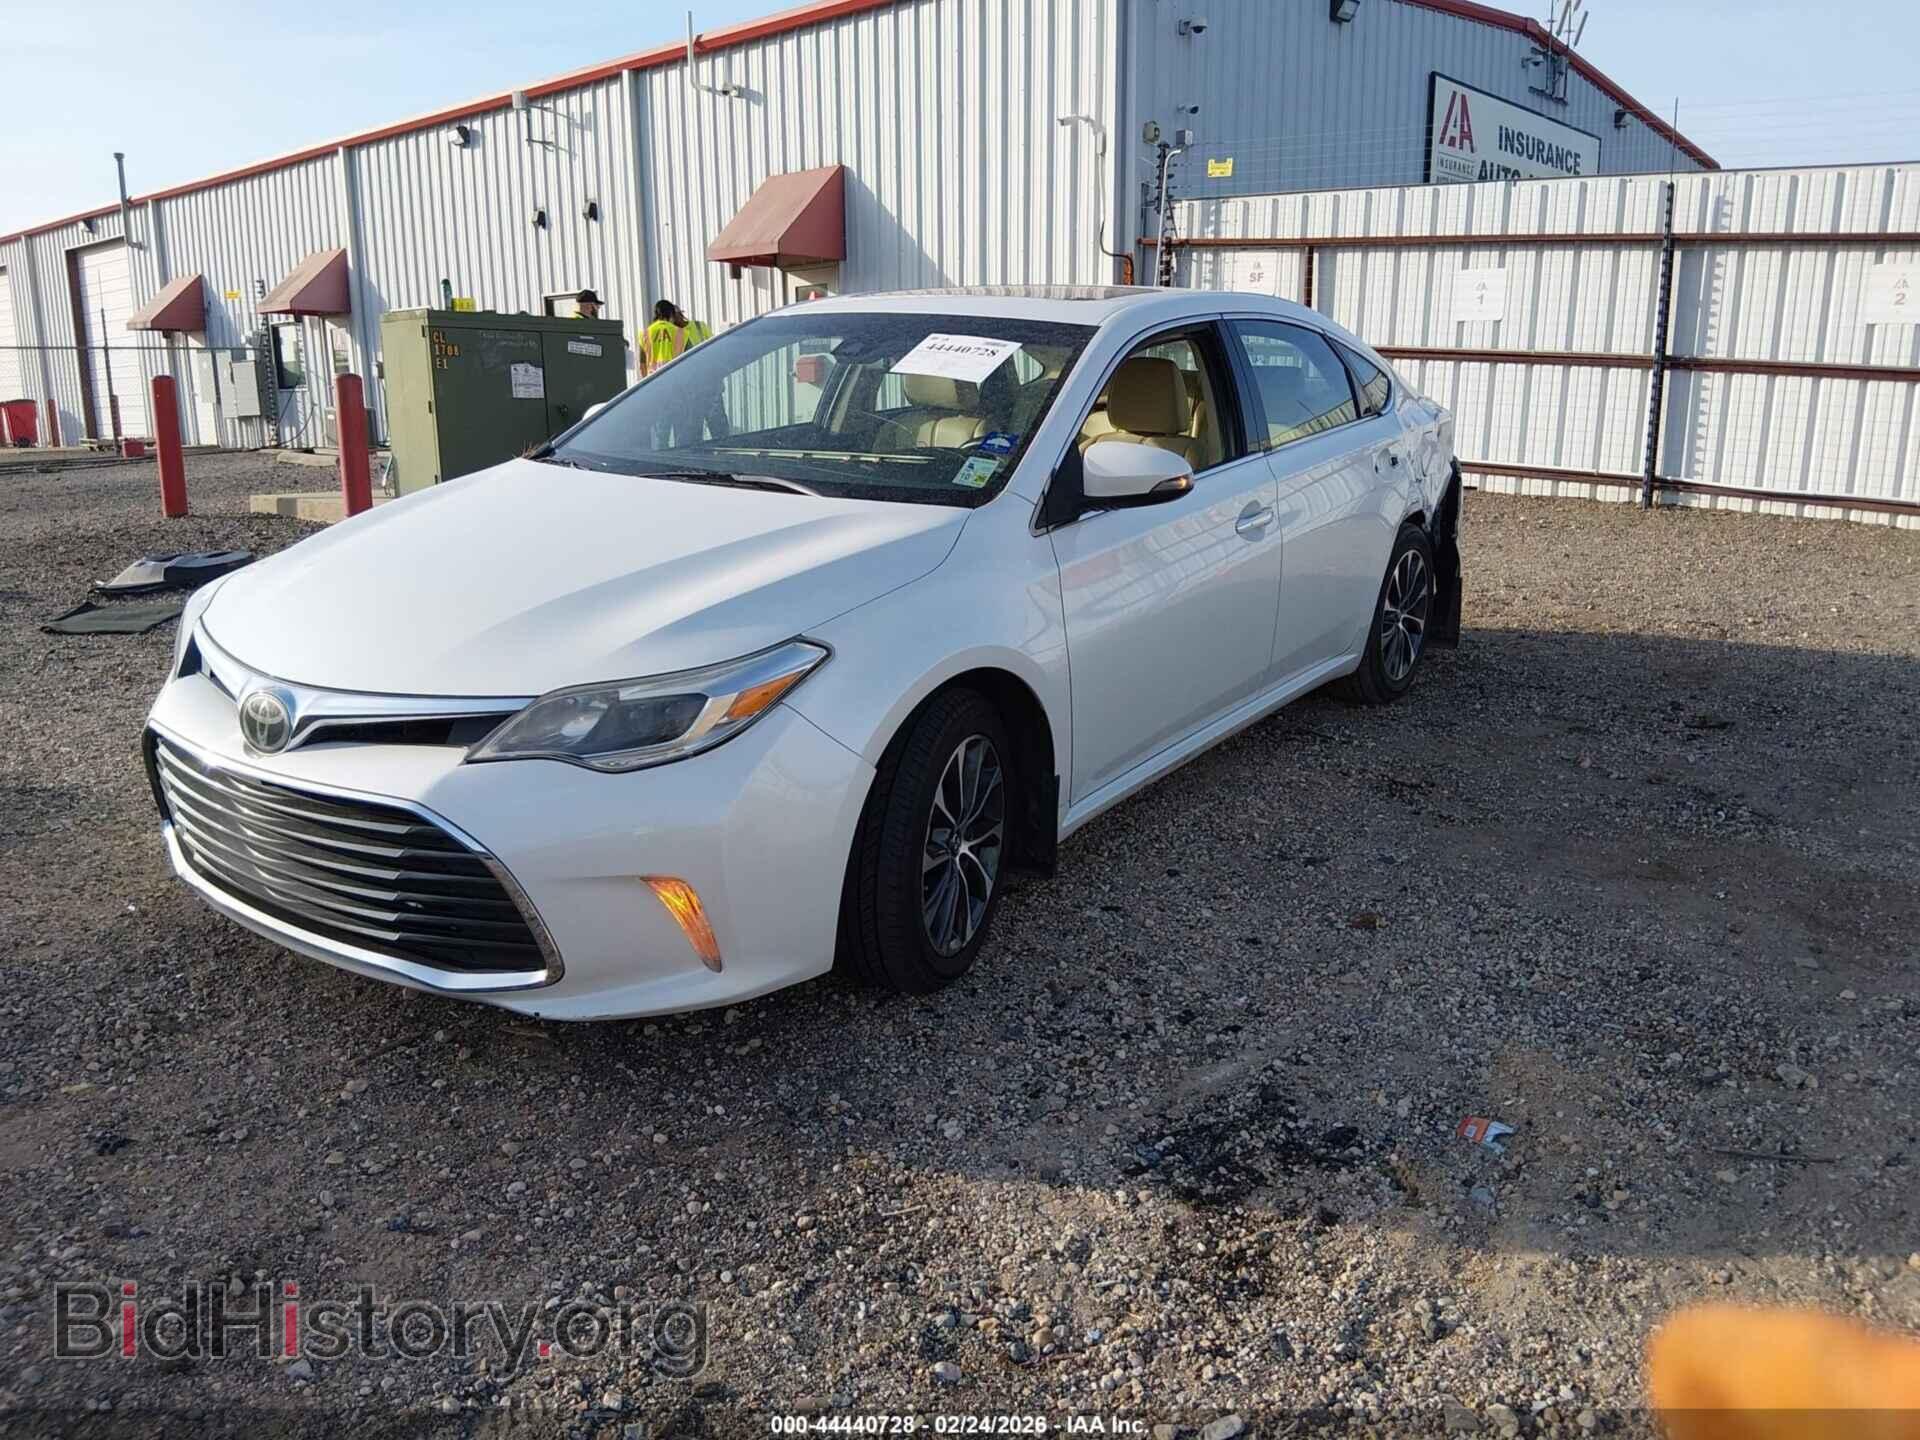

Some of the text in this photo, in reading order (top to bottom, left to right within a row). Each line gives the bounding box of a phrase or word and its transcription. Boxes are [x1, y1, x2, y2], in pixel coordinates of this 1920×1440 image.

[1498, 125, 1581, 175] INSURANCE
[1249, 272, 1264, 282] SF
[1894, 293, 1906, 305] 2
[926, 342, 999, 357] 44440728
